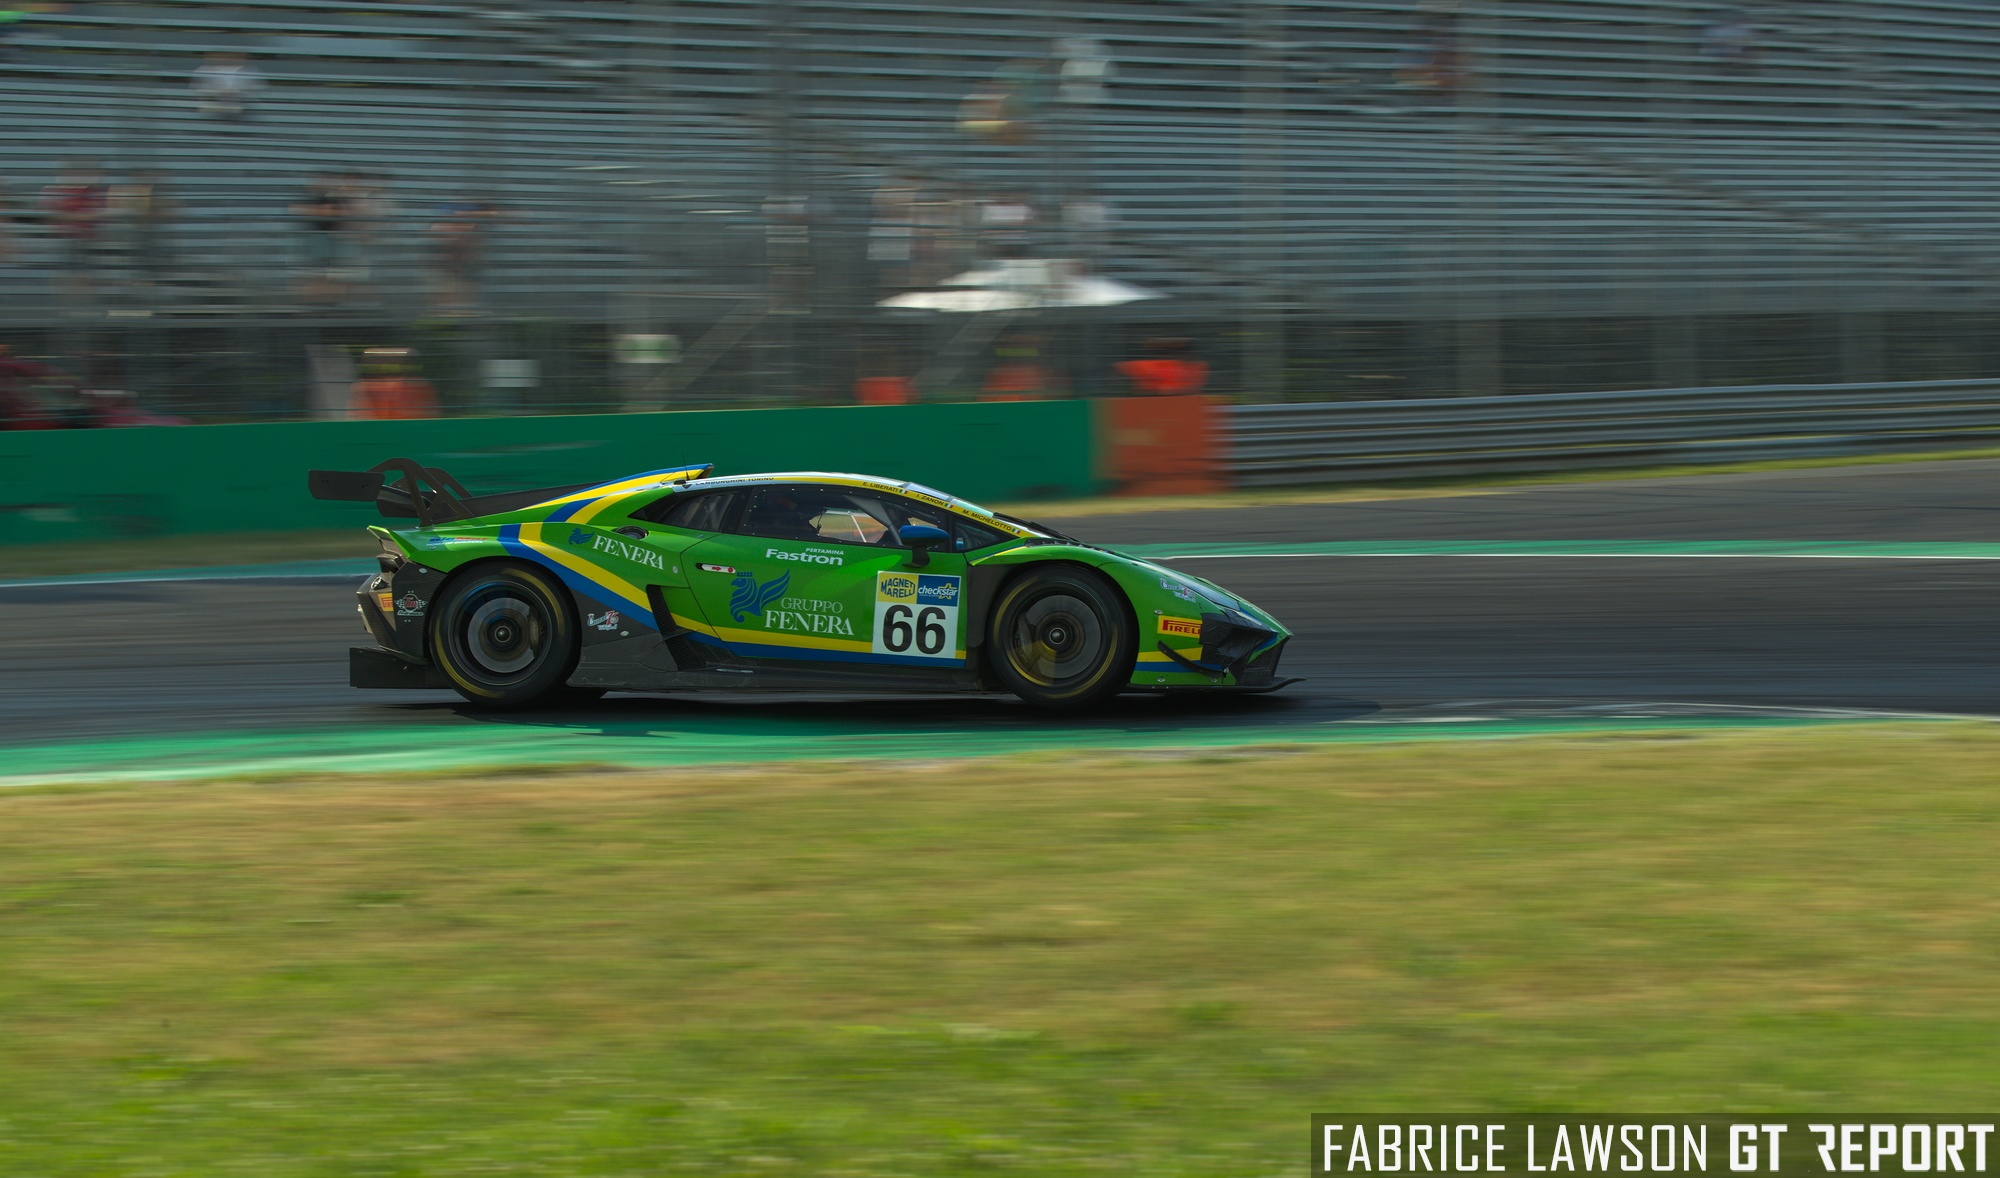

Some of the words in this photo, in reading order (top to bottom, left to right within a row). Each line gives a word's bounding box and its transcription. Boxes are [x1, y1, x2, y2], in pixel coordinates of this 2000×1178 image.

[869, 482, 899, 492] LIBERATI
[921, 494, 945, 506] ZANON
[971, 512, 1012, 531] MICHELOTTO
[592, 534, 664, 570] FENERA
[765, 548, 843, 566] Fastron
[805, 547, 844, 555] PERTAMINA
[918, 585, 958, 596] checkstar
[781, 597, 843, 614] GRUPPO
[764, 609, 855, 636] FENERA
[883, 604, 946, 655] 66
